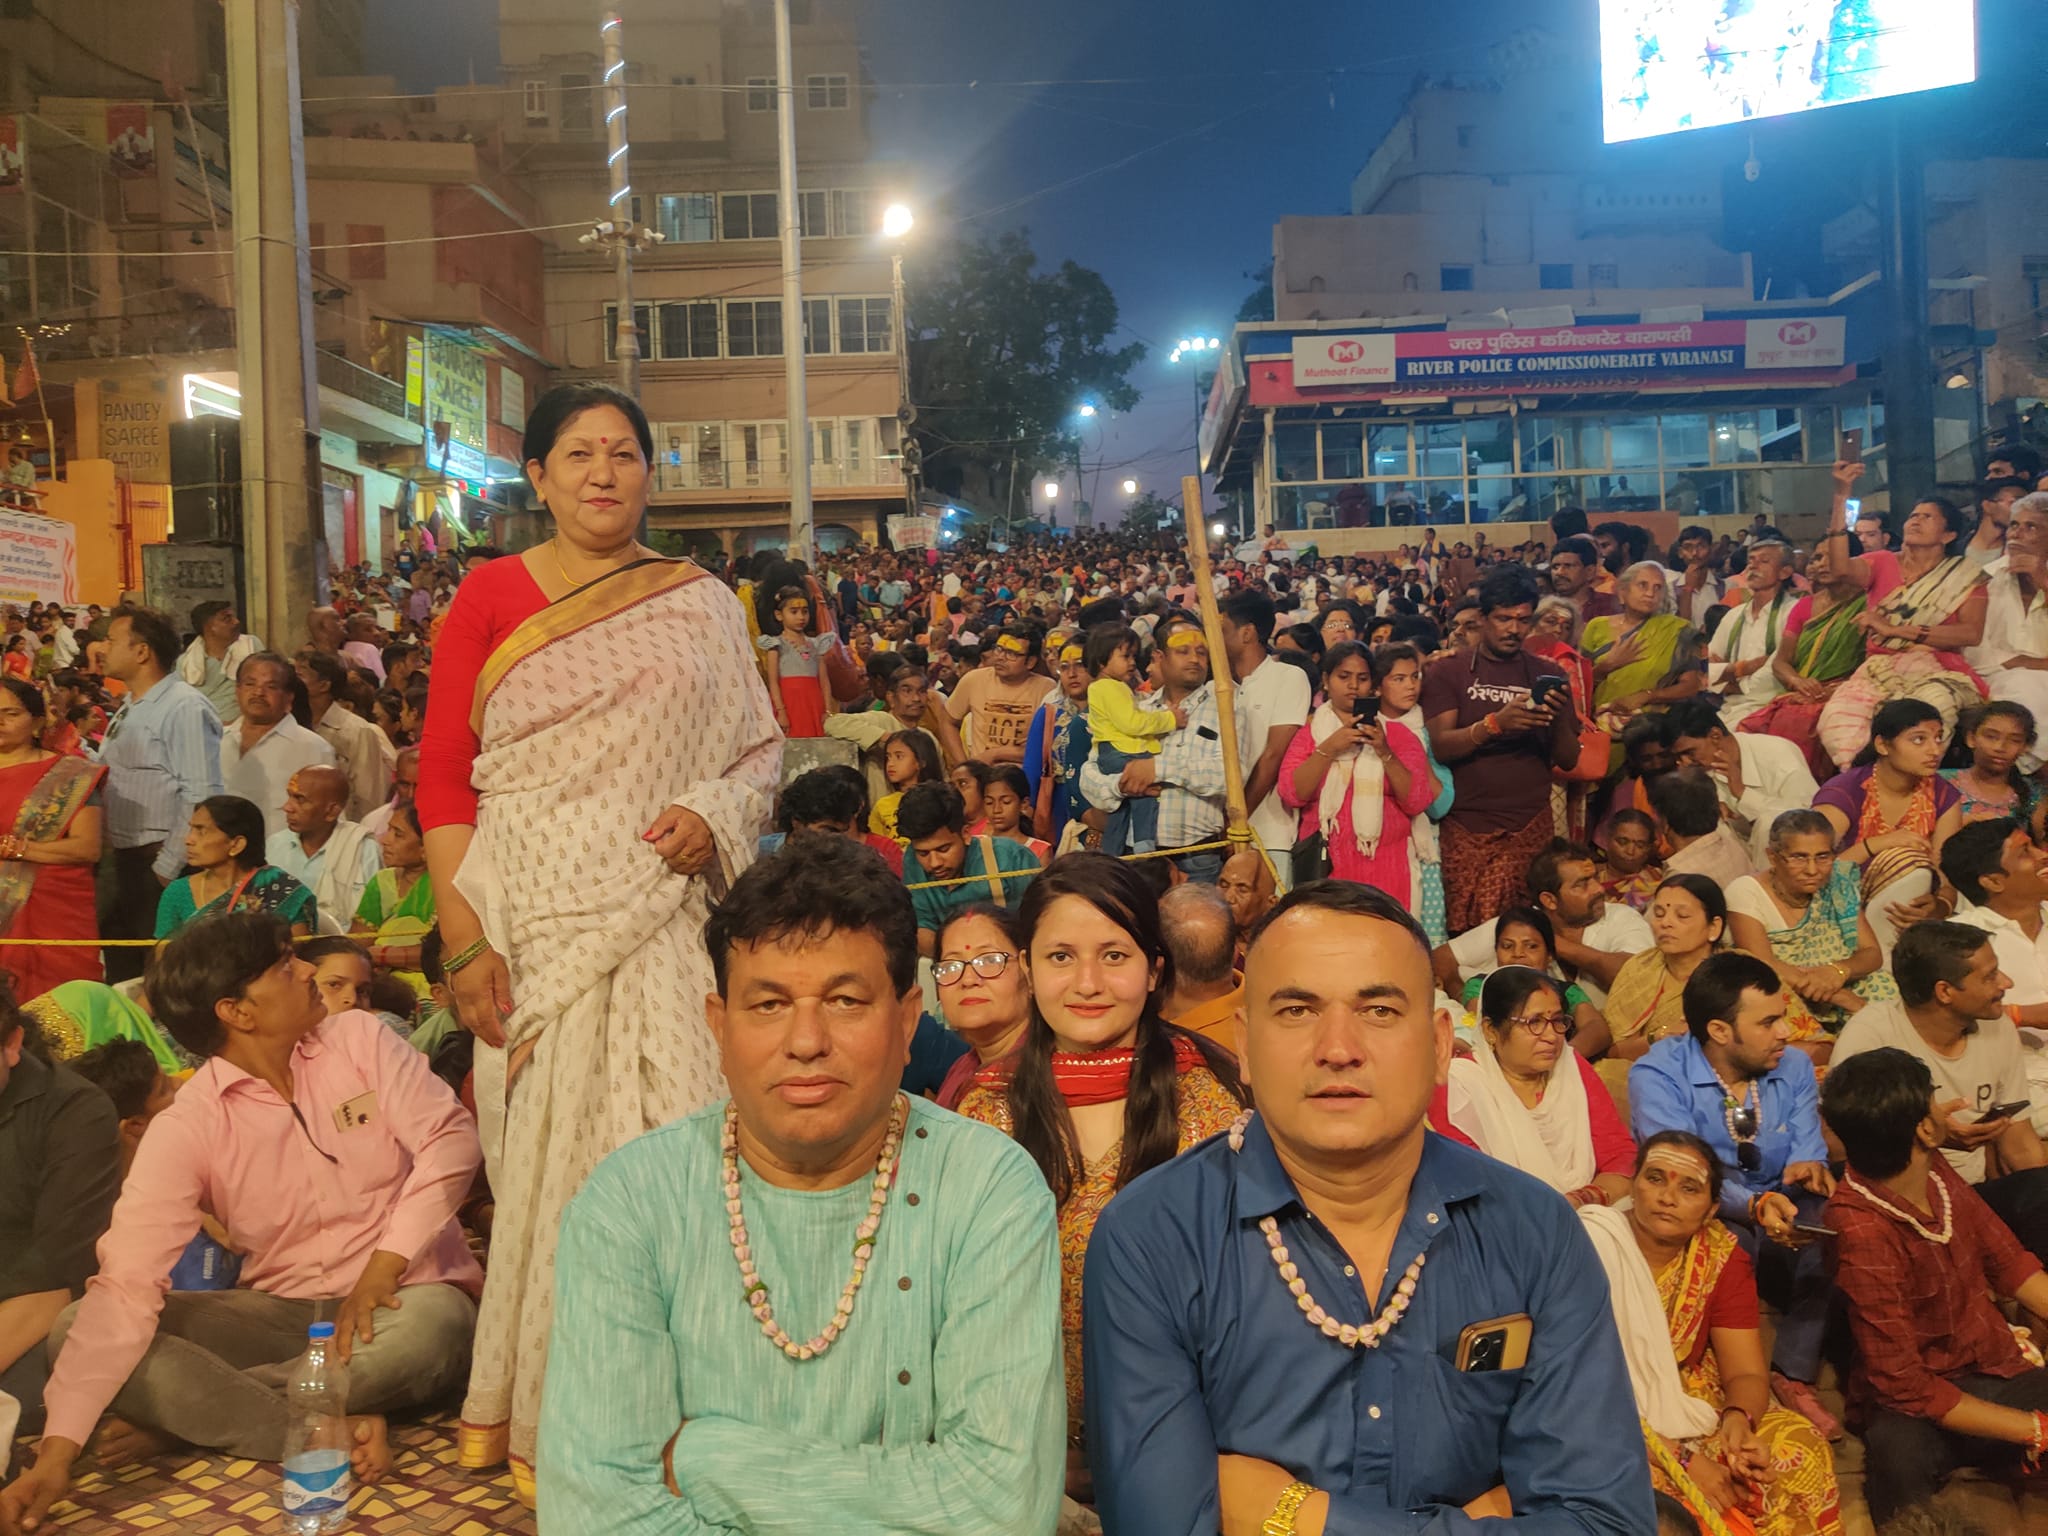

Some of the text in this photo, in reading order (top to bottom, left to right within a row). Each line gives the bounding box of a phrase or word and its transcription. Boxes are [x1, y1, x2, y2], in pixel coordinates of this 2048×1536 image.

[1448, 337, 1482, 350] जल
[1487, 332, 1536, 355] पुलिस
[1304, 366, 1390, 377] Muthoot Finance
[1407, 349, 1734, 376] RIVER POLICE COMMISSIONERATE VARANASI
[104, 402, 161, 421] PANDEY
[105, 426, 160, 446] SAREE
[1467, 686, 1521, 704] ORIGIN
